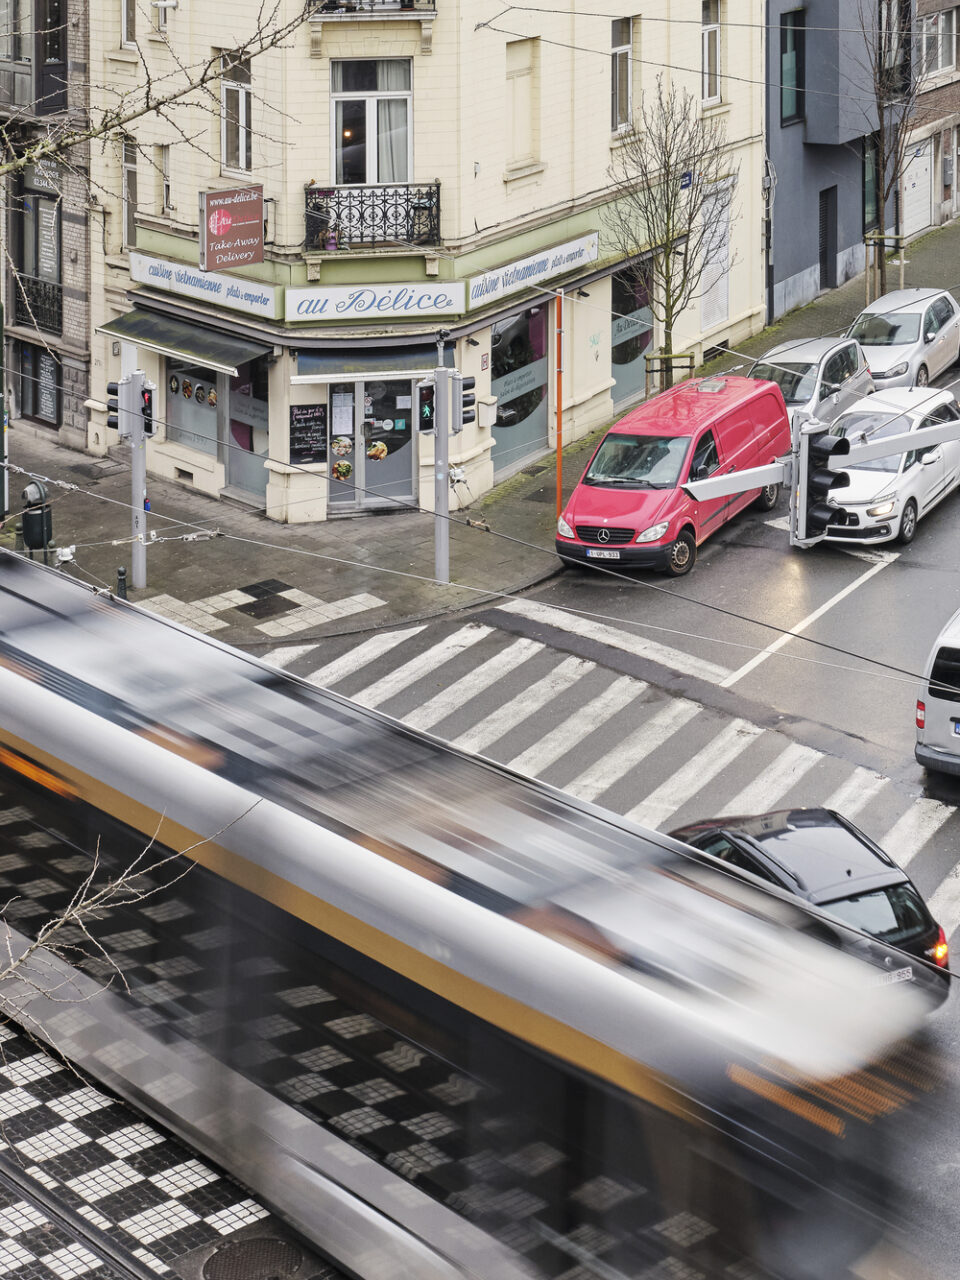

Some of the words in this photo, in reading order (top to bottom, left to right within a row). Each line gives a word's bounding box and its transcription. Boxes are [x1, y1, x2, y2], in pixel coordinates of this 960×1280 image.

[209, 240, 232, 251] Take
[234, 237, 260, 247] Away
[215, 251, 255, 264] Delivery
[297, 298, 328, 314] au
